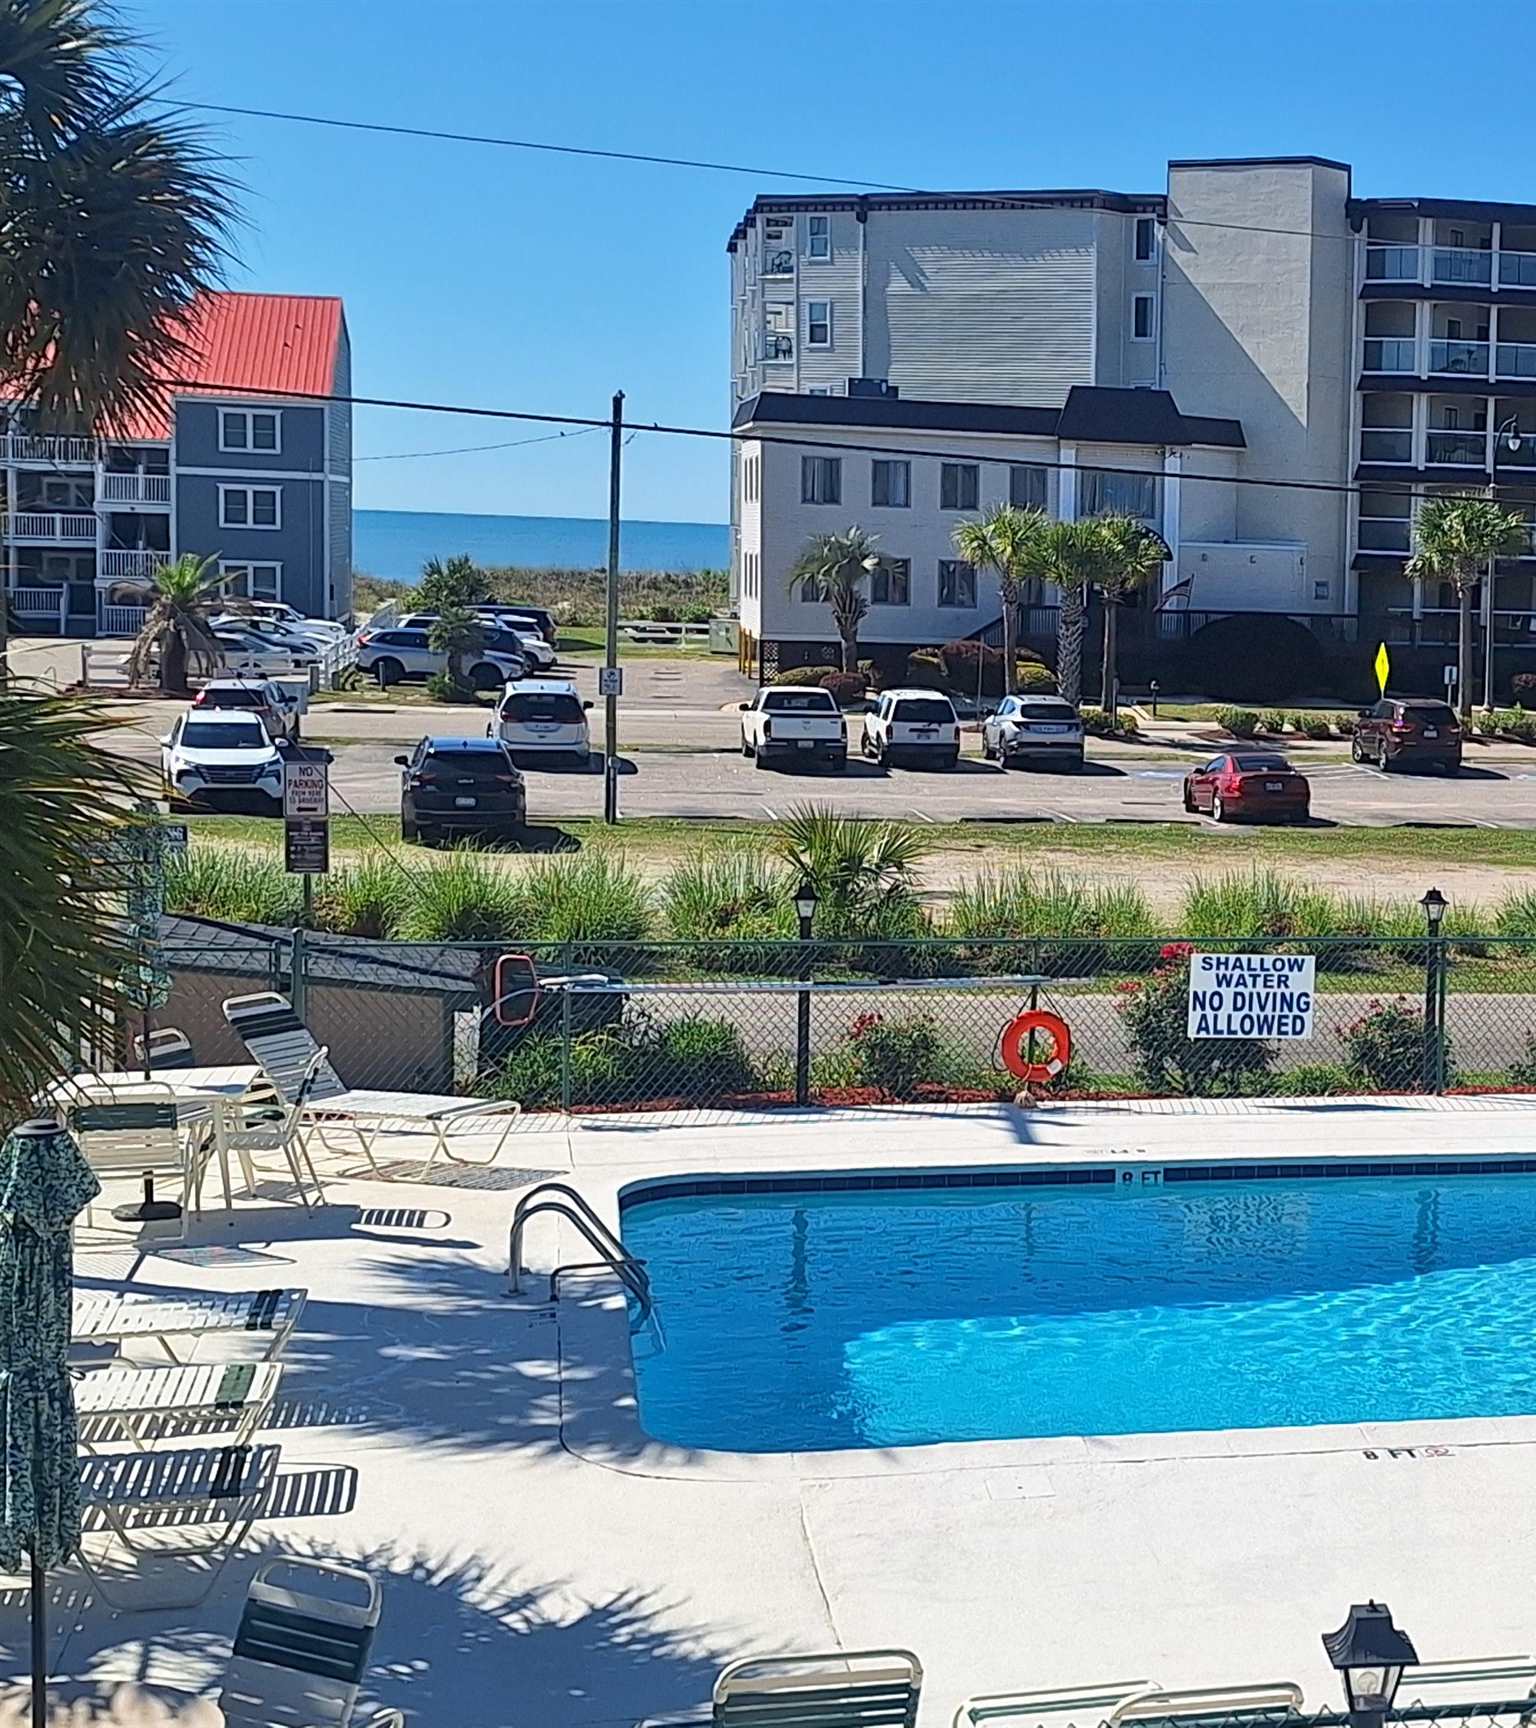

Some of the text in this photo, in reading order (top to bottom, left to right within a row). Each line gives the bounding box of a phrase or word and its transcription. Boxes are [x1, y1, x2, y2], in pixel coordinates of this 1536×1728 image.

[299, 766, 313, 777] NO
[288, 779, 324, 789] PARKING
[1201, 956, 1305, 972] SHALLOW
[1215, 973, 1290, 989] WATER
[1192, 991, 1311, 1013] NO DIVING
[1196, 1013, 1306, 1036] ALLOWED
[1141, 1170, 1162, 1184] FT
[1363, 1448, 1416, 1460] 8 FT
